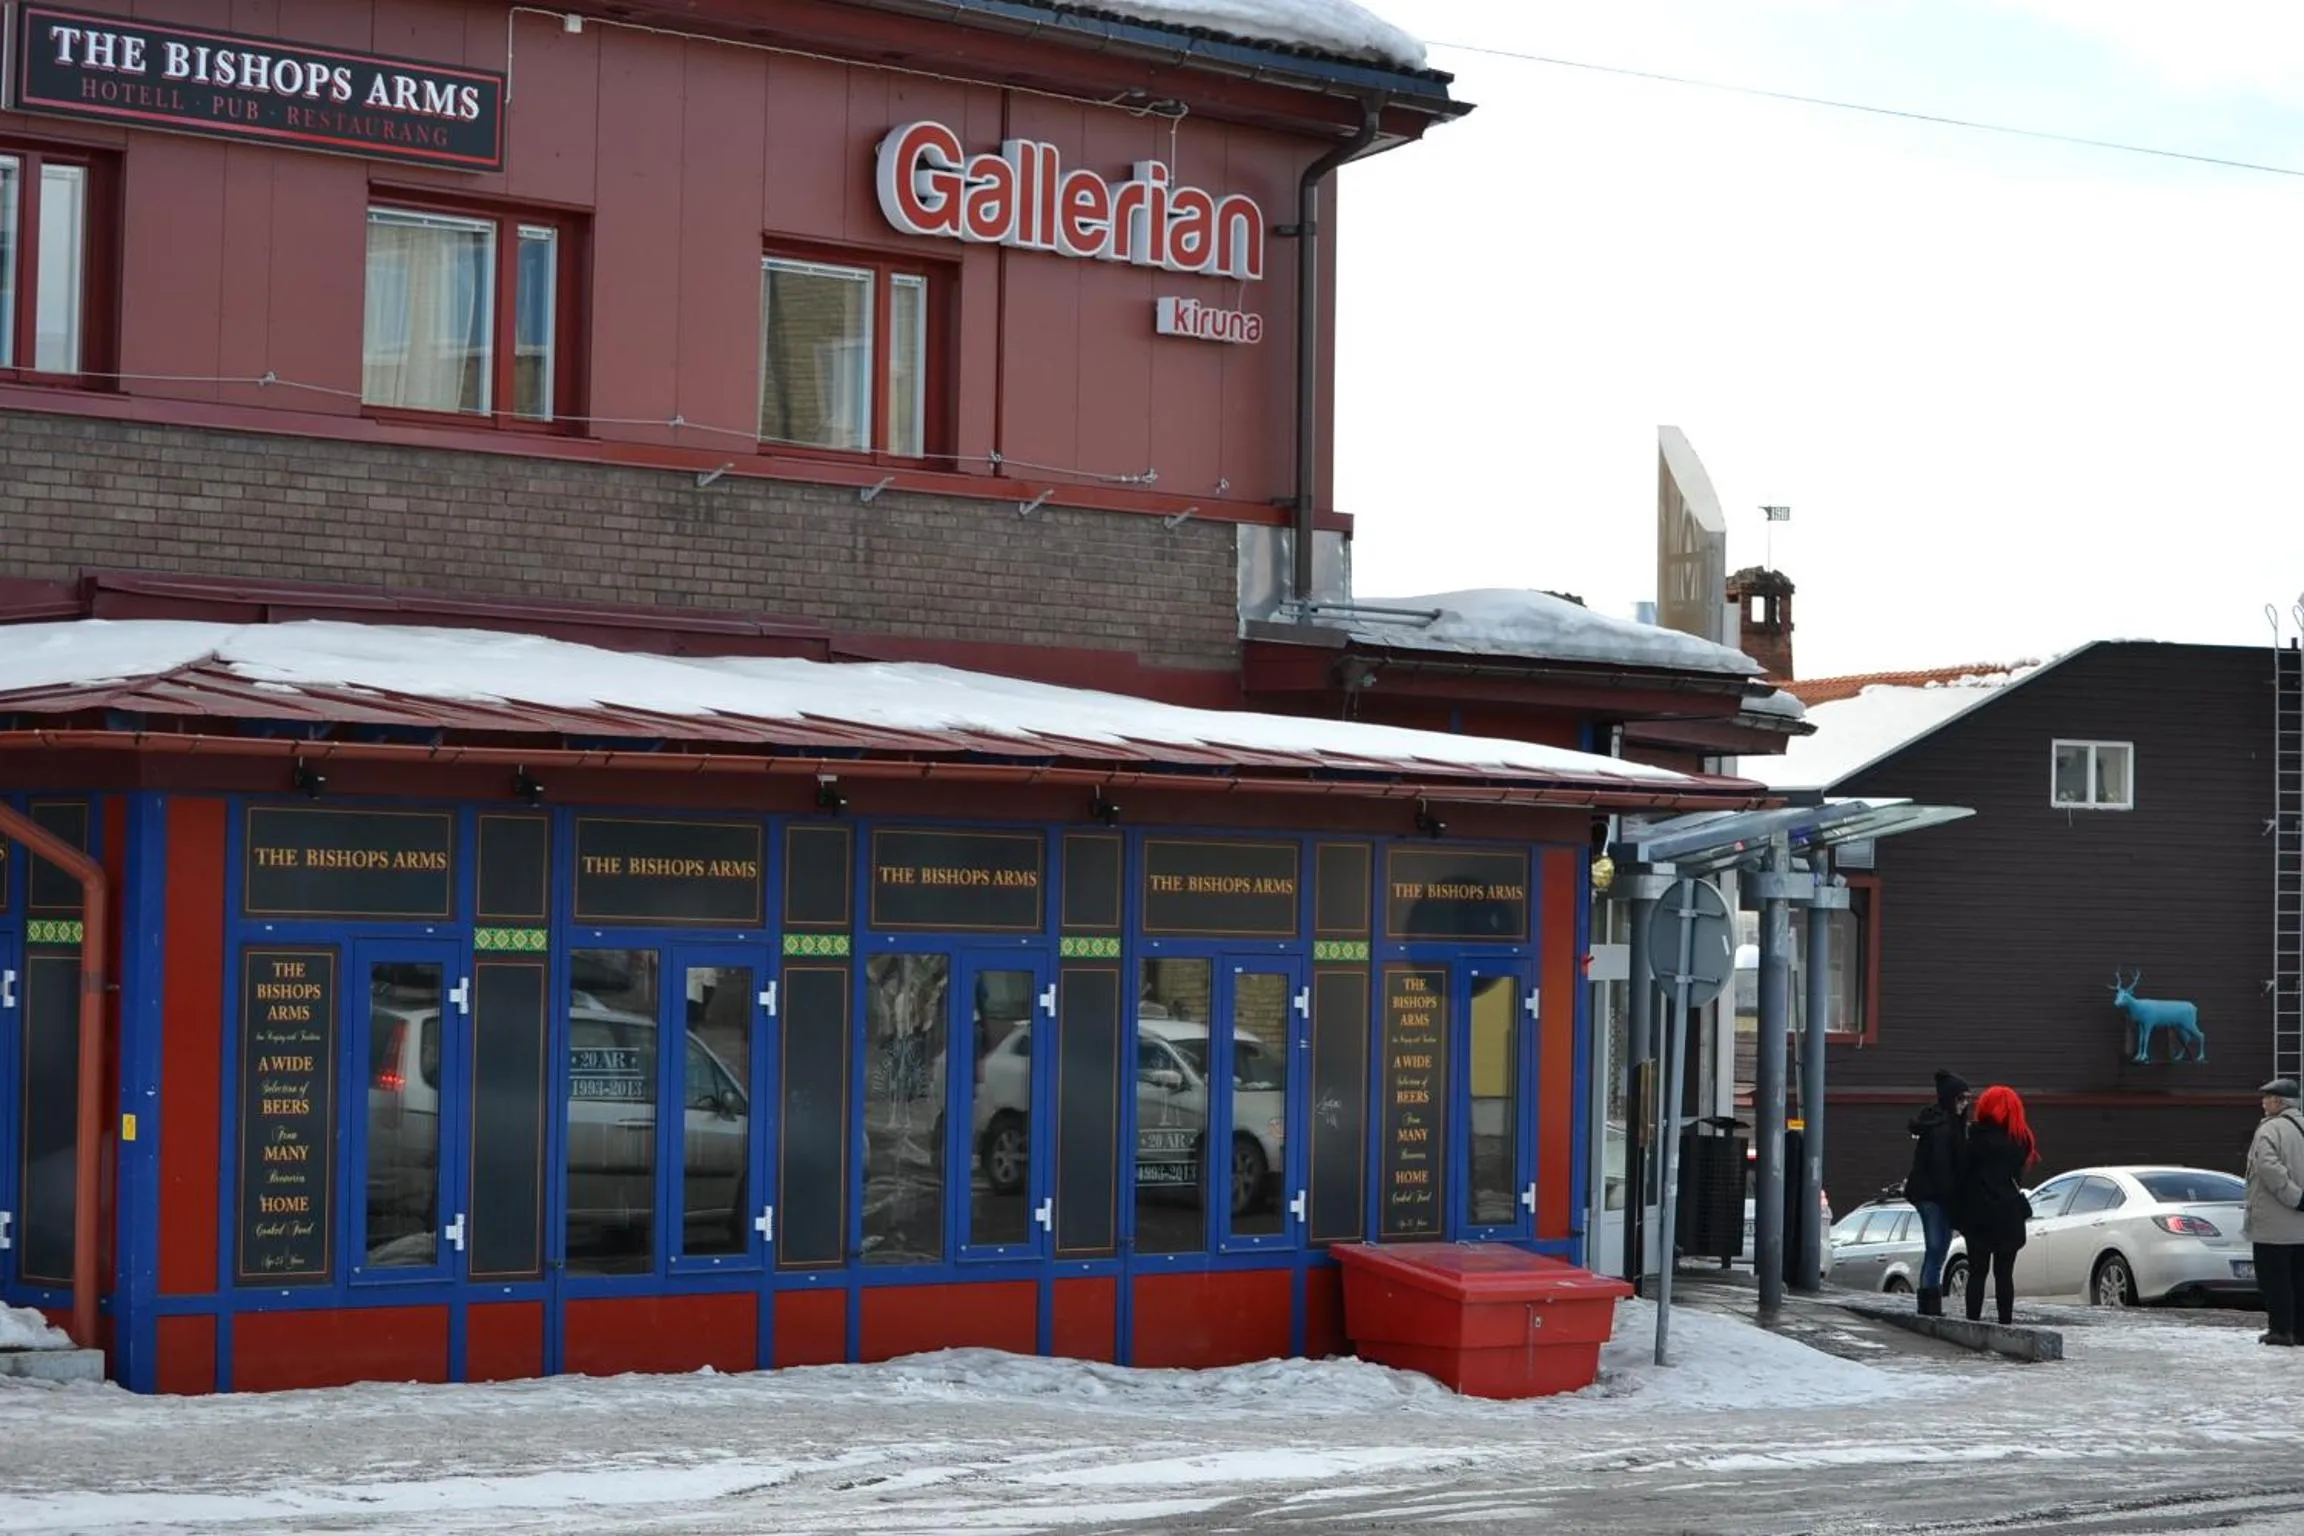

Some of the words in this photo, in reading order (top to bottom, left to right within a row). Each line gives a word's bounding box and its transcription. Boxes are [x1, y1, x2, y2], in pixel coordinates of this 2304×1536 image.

[50, 25, 147, 76] THE
[162, 41, 352, 104] BISHOPS
[364, 72, 480, 122] ARMS
[81, 77, 184, 110] HOTELL
[212, 95, 259, 120] PUB
[286, 105, 449, 146] RESTAURANG
[880, 120, 1264, 281] Gallerian
[1172, 296, 1264, 344] kiruna
[255, 848, 298, 866] THE
[306, 849, 388, 869] BISHOPS
[393, 851, 447, 870] ARMS
[582, 856, 621, 873] THE
[629, 857, 704, 876] BISHOPS
[708, 860, 757, 878] ARMS
[879, 866, 915, 883] THE
[921, 867, 989, 885] BISHOPS
[993, 869, 1038, 887] ARMS
[1150, 874, 1182, 891] THE
[1189, 875, 1250, 893] BISHOPS
[1253, 878, 1294, 894] ARMS
[1393, 882, 1422, 898] THE
[1427, 884, 1484, 900] BISHOPS
[1487, 885, 1524, 900] ARMS
[272, 962, 305, 978] THE
[257, 983, 321, 1000] BISHOPS
[1402, 977, 1427, 991] THE
[1392, 995, 1438, 1009] BISHOPS
[267, 1005, 310, 1021] ARMS
[1400, 1012, 1430, 1027] ARMS
[258, 1056, 269, 1072] A
[271, 1055, 314, 1072] WIDE
[580, 1051, 597, 1067] 20
[1392, 1055, 1402, 1069] A
[1402, 1055, 1433, 1069] WIDE
[1396, 1090, 1430, 1104] BEERS
[262, 1099, 310, 1115] BEERS
[1397, 1128, 1428, 1143] MANY
[263, 1144, 309, 1161] MANY
[1395, 1170, 1430, 1184] HOME
[261, 1195, 310, 1212] HOME
